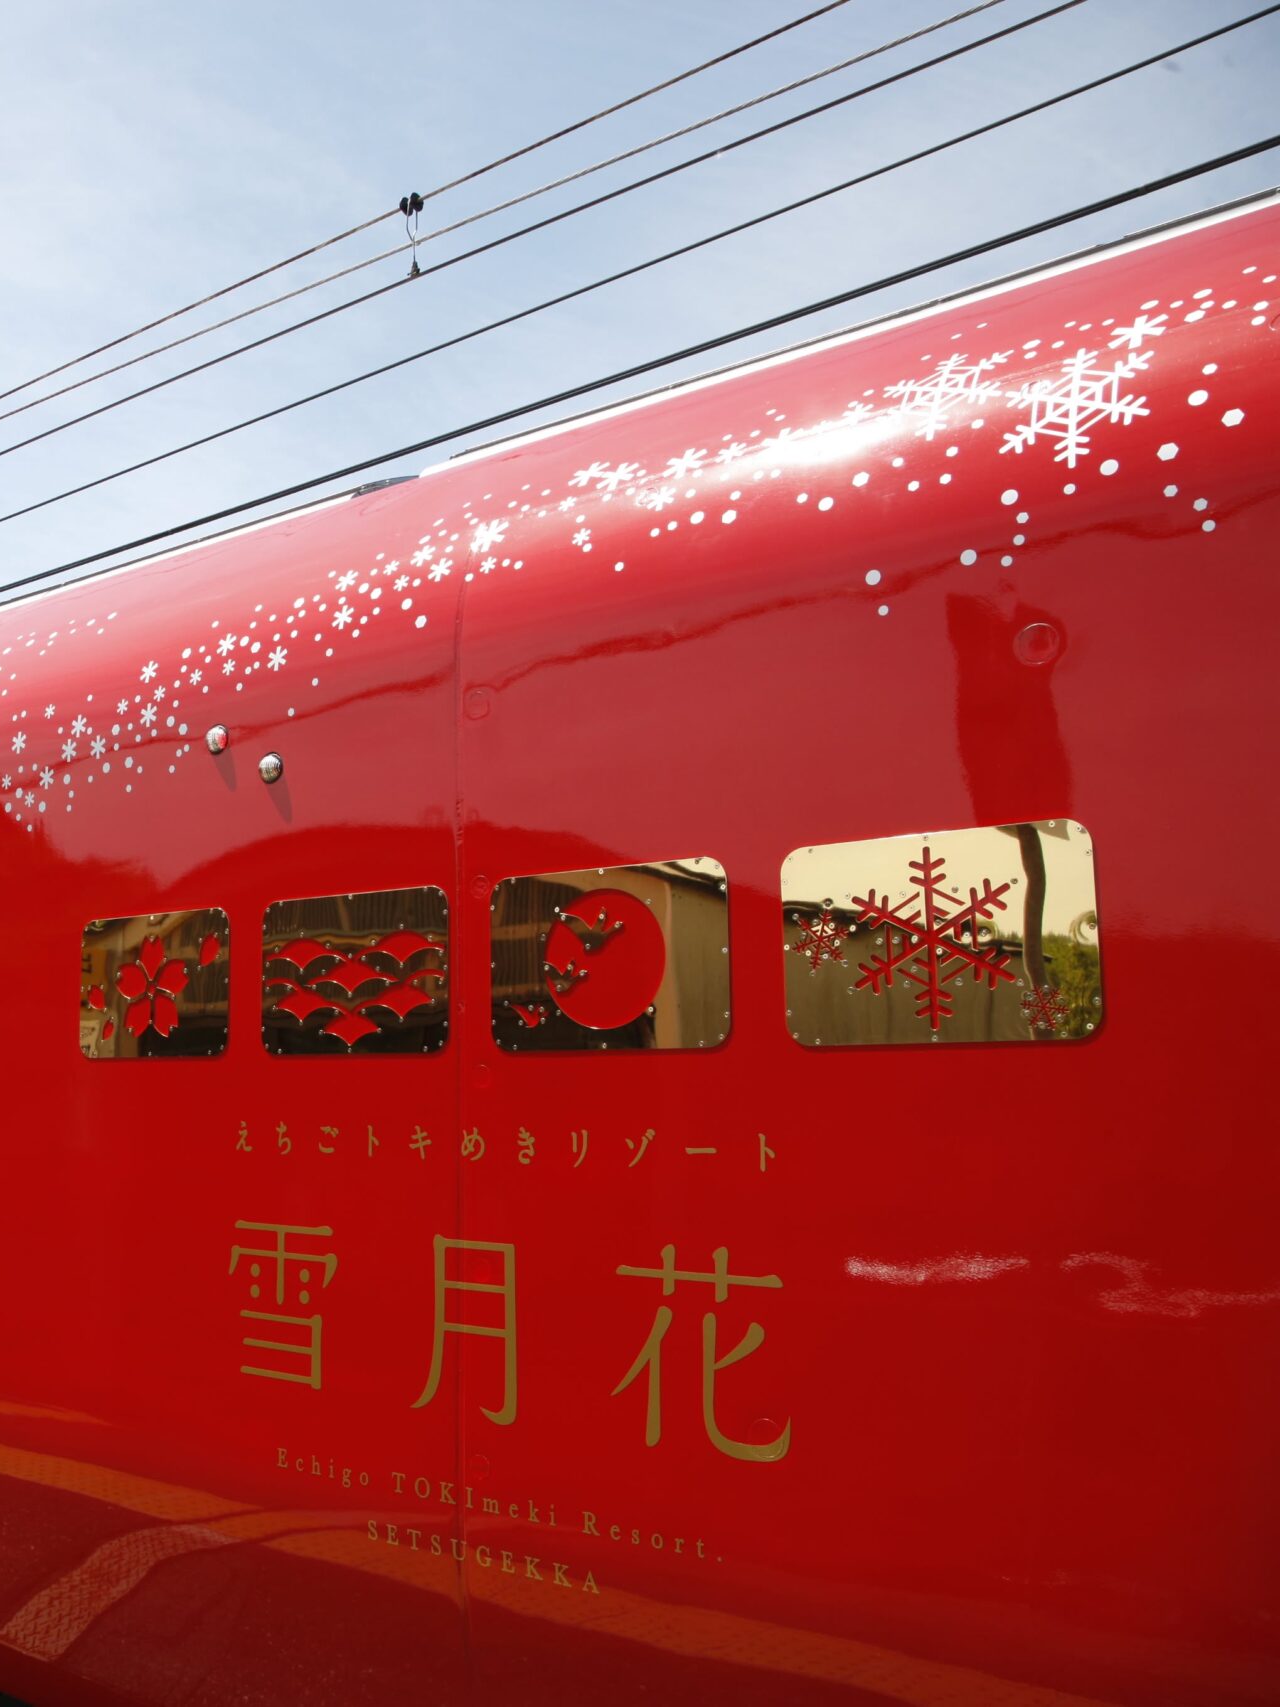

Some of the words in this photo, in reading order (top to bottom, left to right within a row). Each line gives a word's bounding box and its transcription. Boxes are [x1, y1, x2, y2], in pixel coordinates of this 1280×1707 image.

[236, 1120, 776, 1173] えちごトキめきリゾート
[228, 1219, 791, 1463] 雪月花
[276, 1447, 370, 1488] Echigo
[390, 1471, 558, 1527] TOKImeki
[581, 1510, 725, 1563] Resort.
[366, 1519, 601, 1595] SETSUGEKKA
